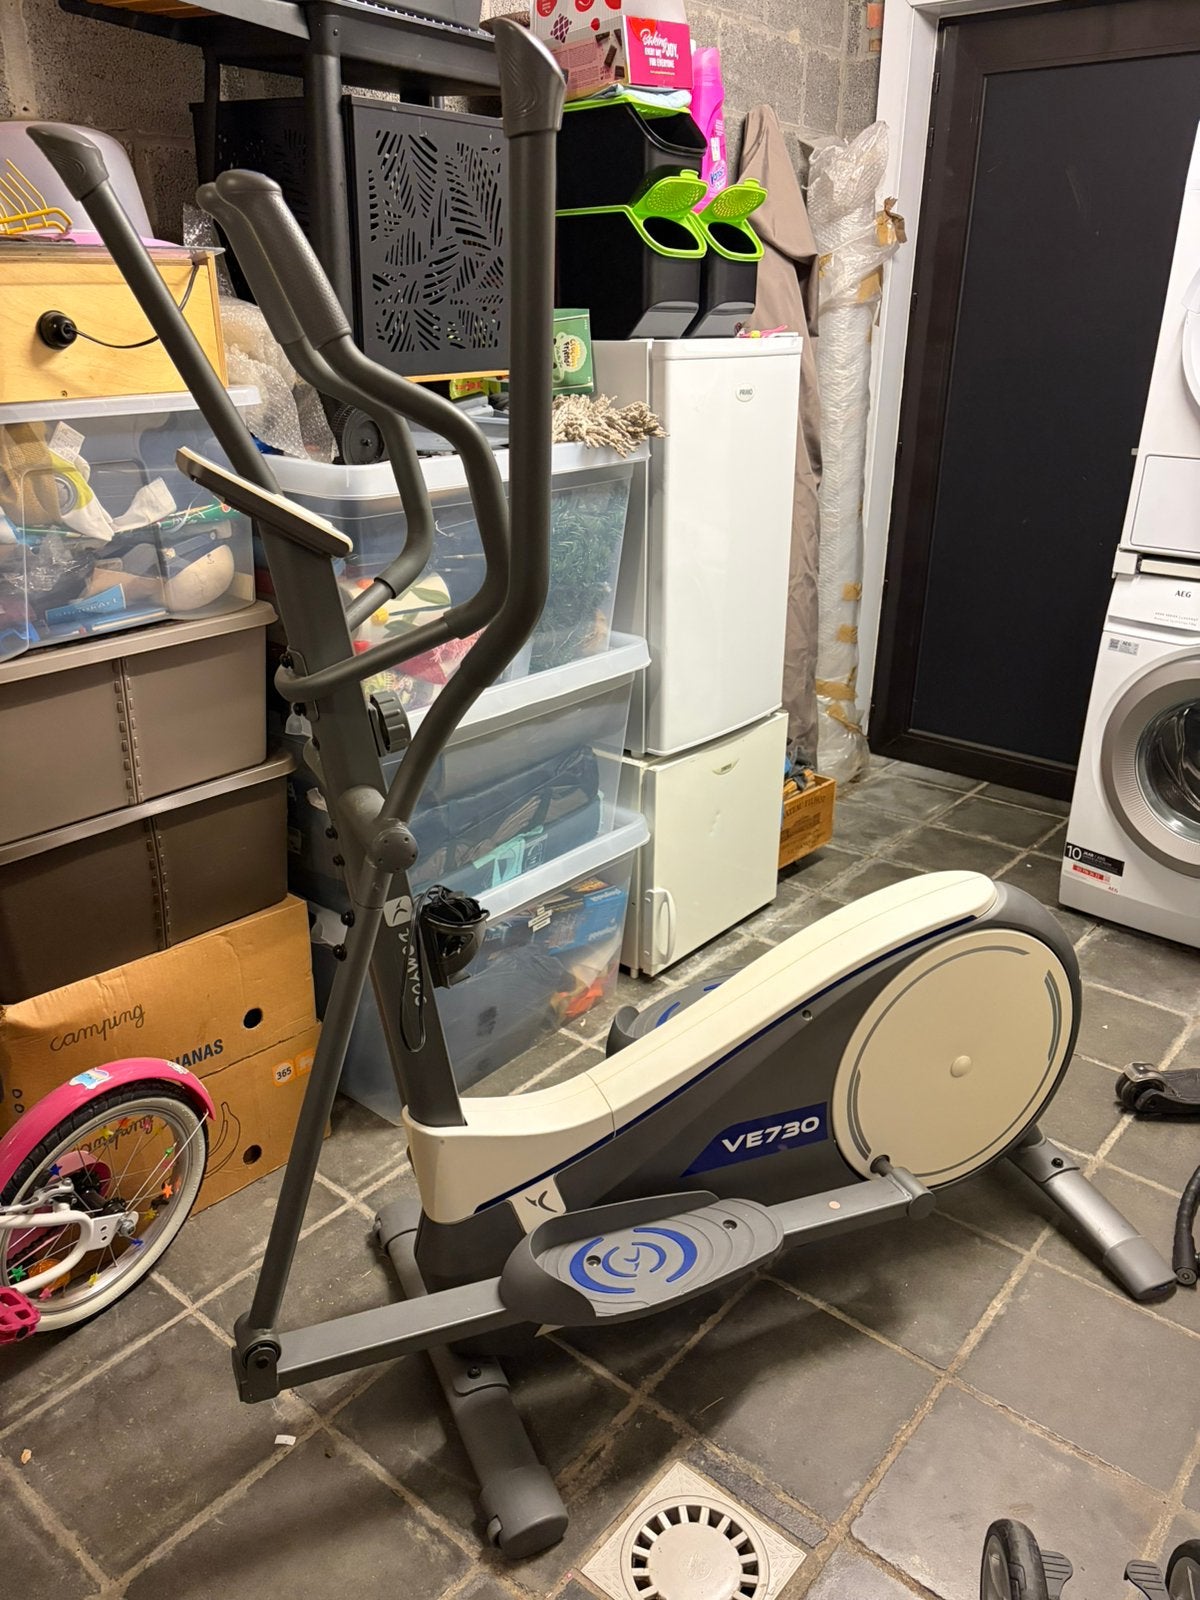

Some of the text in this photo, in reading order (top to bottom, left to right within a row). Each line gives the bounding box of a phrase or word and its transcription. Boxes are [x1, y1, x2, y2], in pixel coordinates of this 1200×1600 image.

[1175, 590, 1191, 598] AEG
[1066, 845, 1082, 861] 10
[50, 1004, 145, 1051] camping
[276, 1066, 292, 1081] 365
[721, 1116, 820, 1153] VE730
